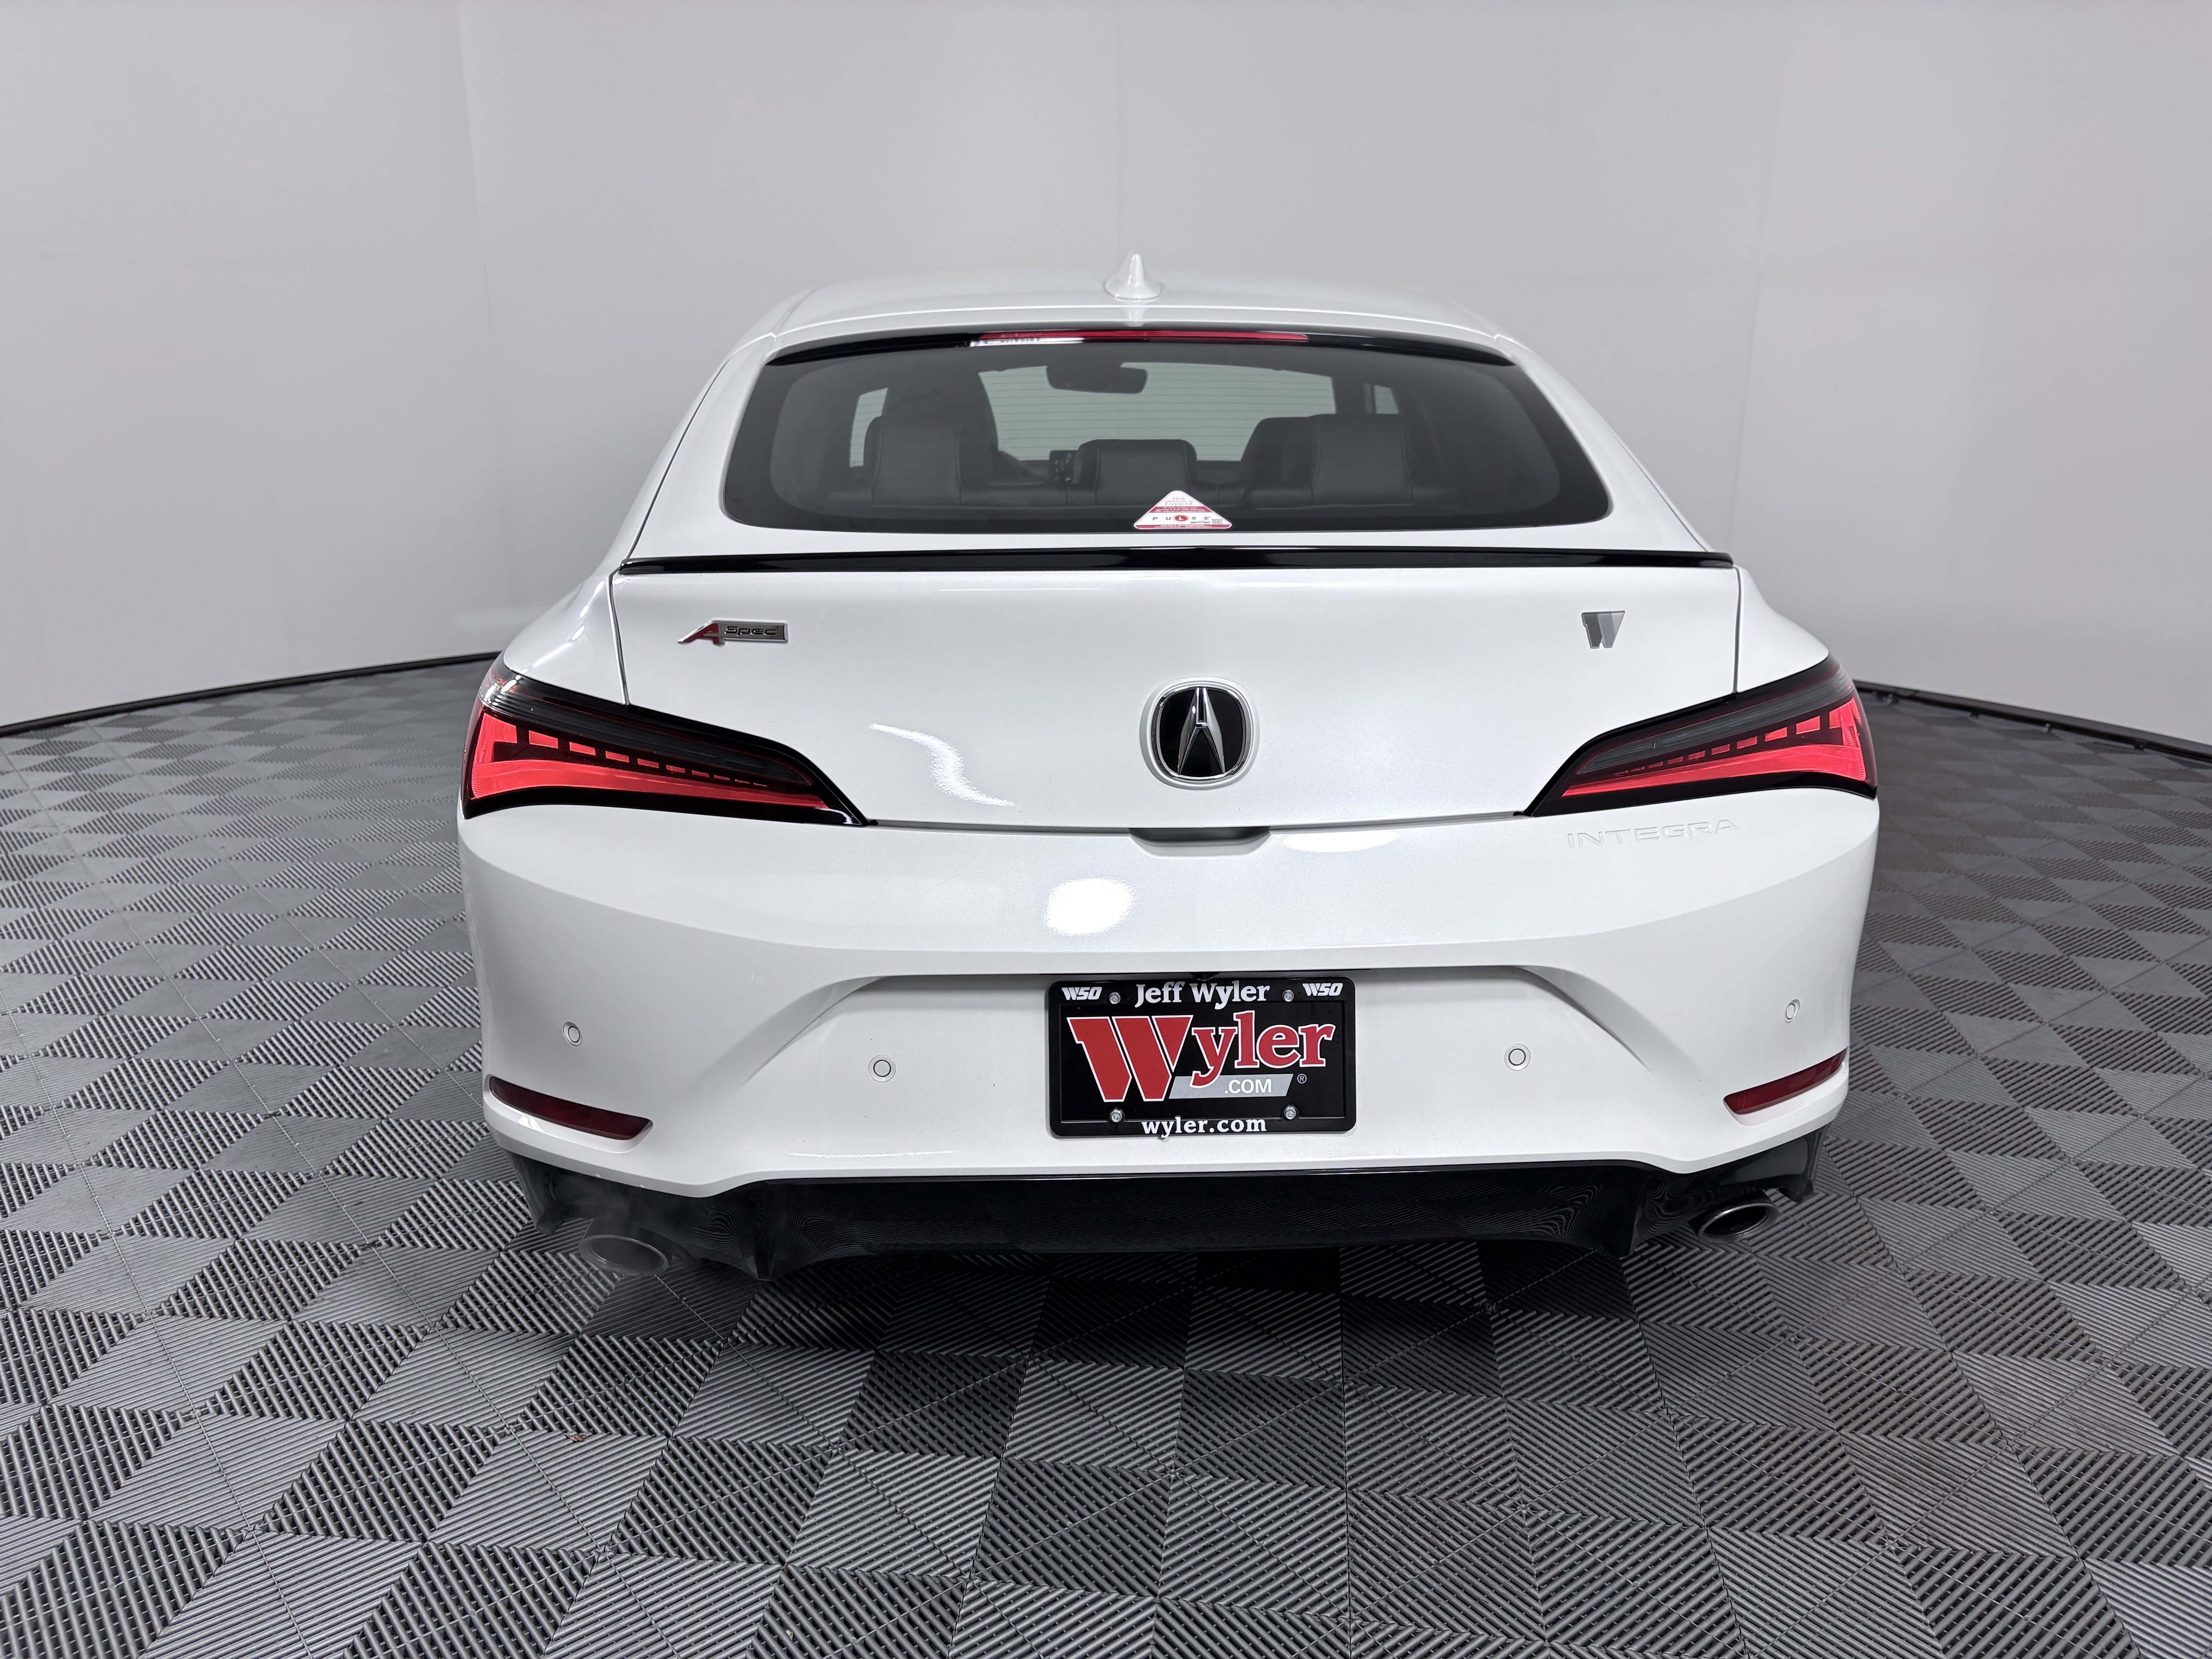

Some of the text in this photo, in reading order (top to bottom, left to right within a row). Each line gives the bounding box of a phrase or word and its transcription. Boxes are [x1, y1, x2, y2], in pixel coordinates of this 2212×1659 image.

[1567, 819, 1740, 848] INTEGRA
[1134, 981, 1271, 1009] Jeff Wyler
[1066, 1010, 1336, 1102] Wyler
[1141, 1116, 1267, 1139] wyler.com
